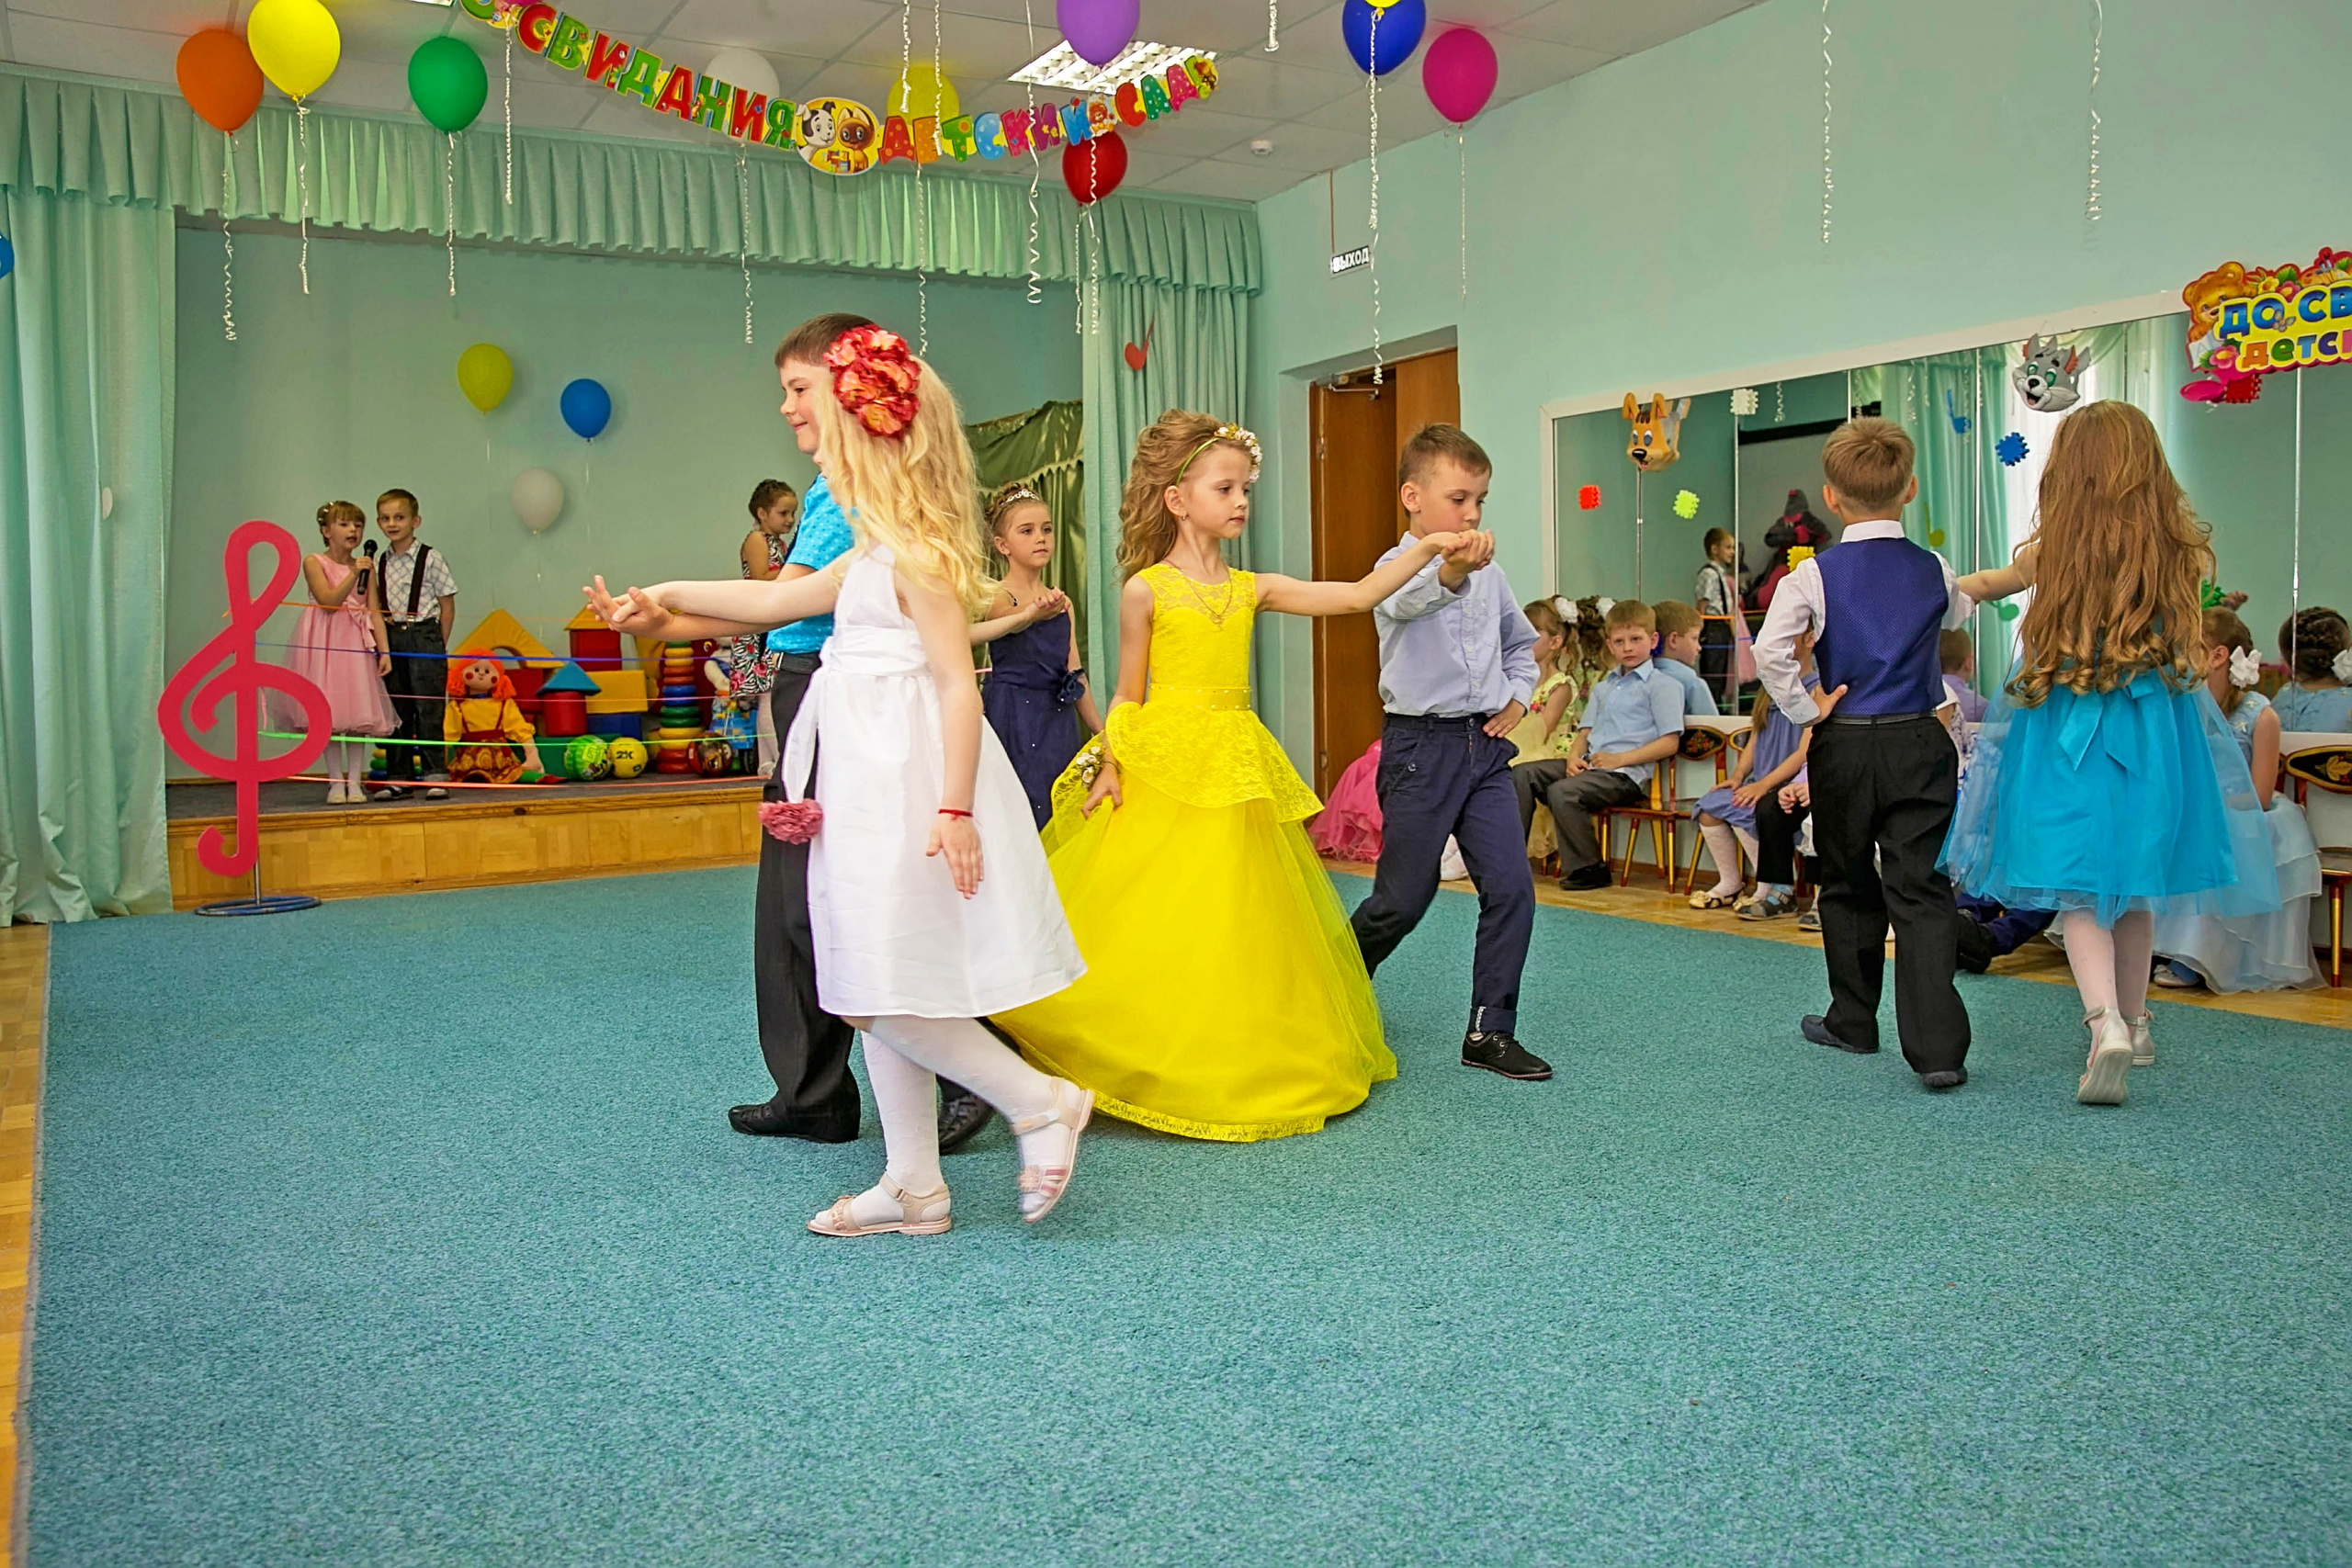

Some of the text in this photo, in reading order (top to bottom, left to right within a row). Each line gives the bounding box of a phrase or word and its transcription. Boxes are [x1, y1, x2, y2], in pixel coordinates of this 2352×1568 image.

[517, 3, 797, 152] СВИДАНИЯ
[877, 97, 1093, 164] ДЕТСКИЙ
[1332, 247, 1370, 273] ВЫХОД
[2219, 298, 2286, 339] ДО
